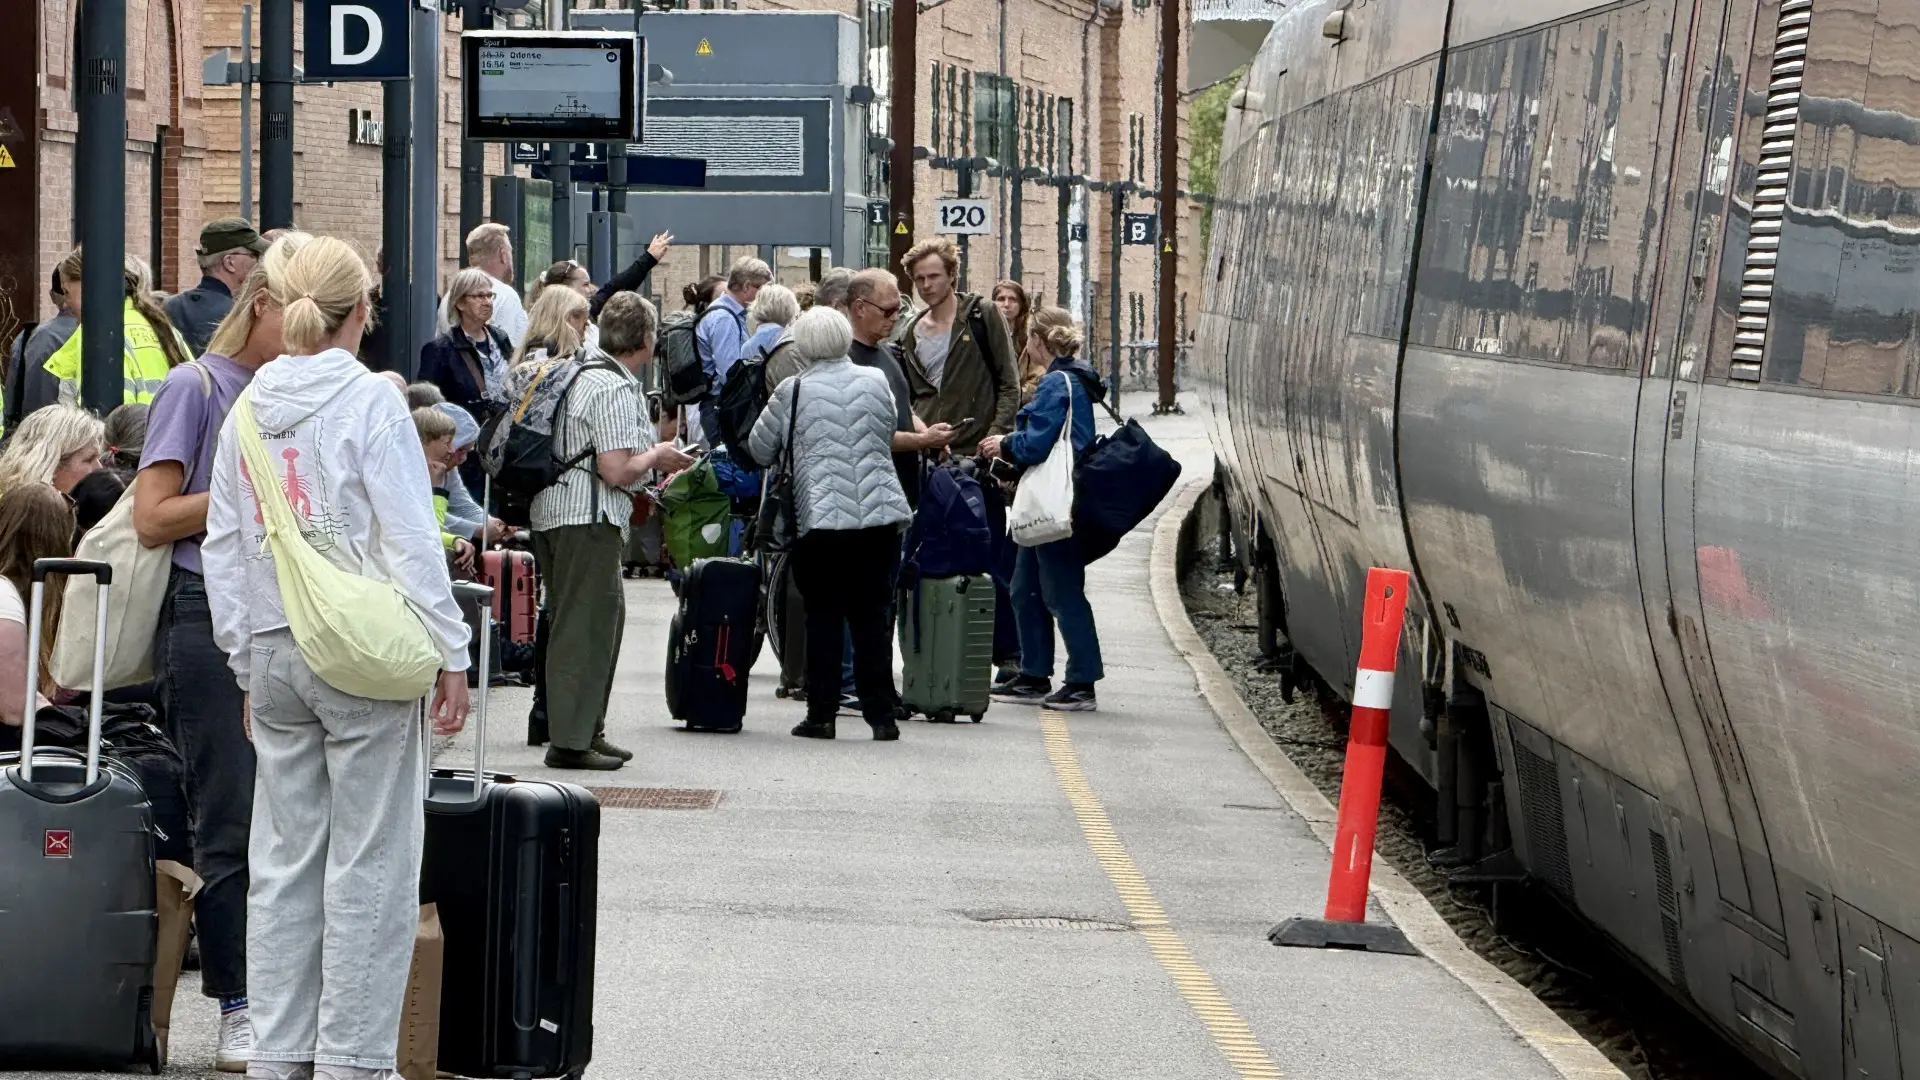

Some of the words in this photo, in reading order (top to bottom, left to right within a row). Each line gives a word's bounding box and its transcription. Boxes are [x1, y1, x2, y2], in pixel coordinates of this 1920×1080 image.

[331, 5, 382, 65] D
[585, 142, 597, 159] 1
[872, 209, 884, 223] 1
[941, 206, 986, 228] 120
[1131, 222, 1147, 241] B
